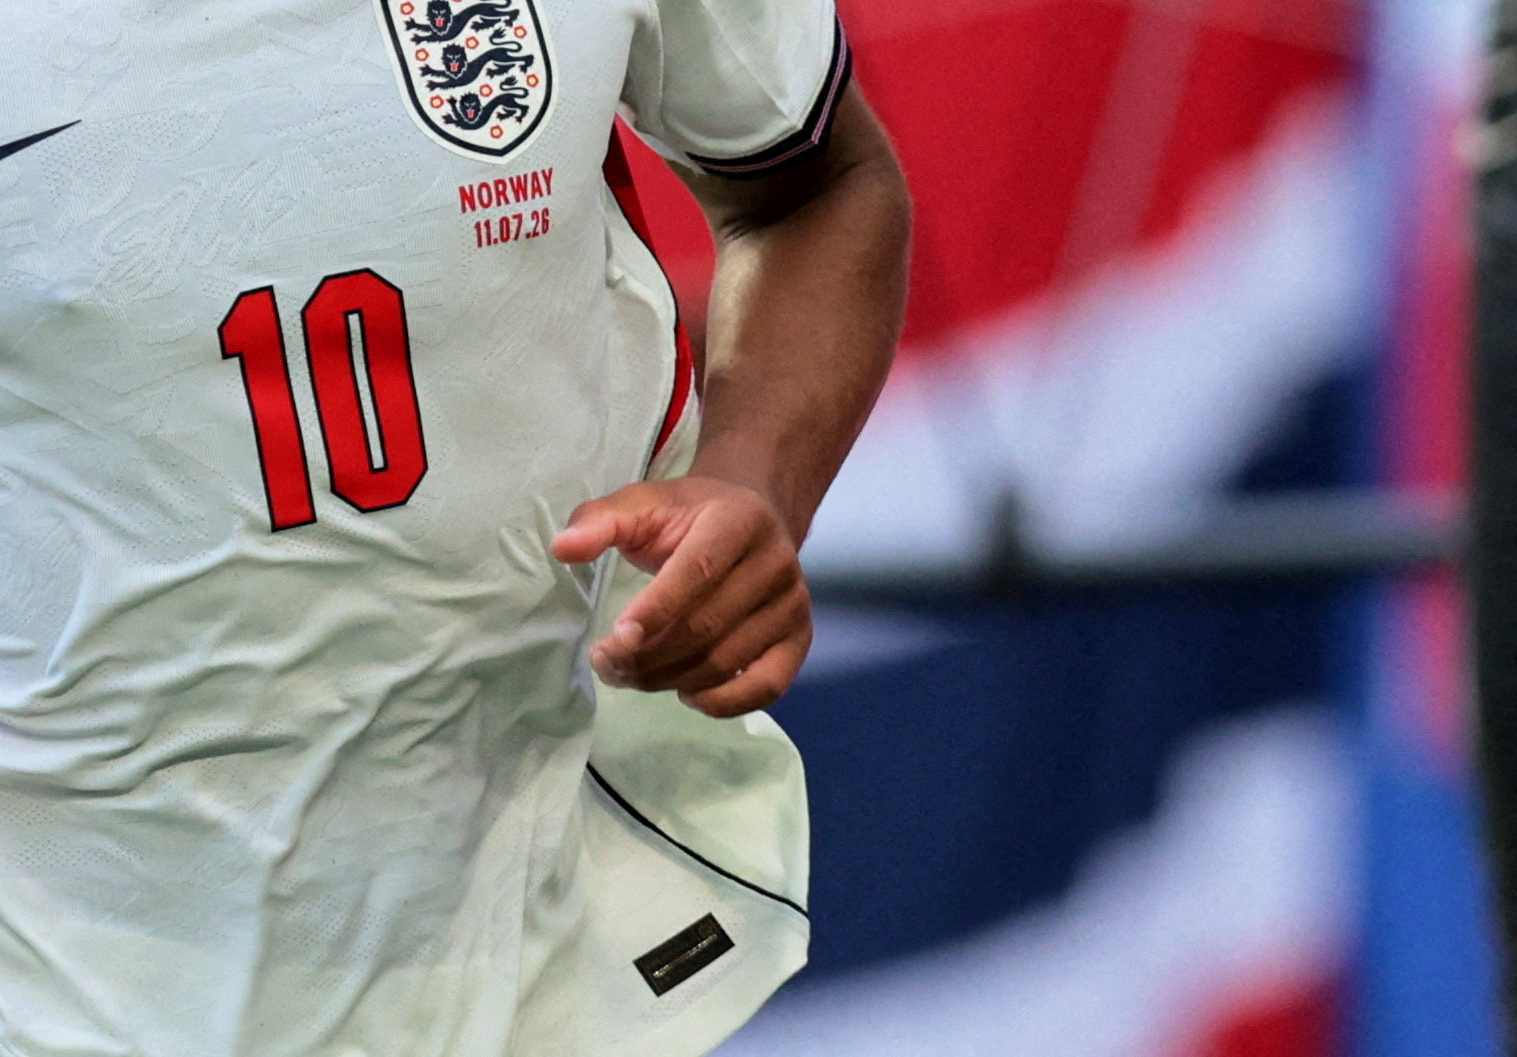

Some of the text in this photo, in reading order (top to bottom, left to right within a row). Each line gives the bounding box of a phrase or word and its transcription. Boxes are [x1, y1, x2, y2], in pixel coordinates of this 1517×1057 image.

[458, 167, 553, 213] NORWAY
[474, 208, 550, 247] 11.07.26
[217, 267, 428, 532] 10
